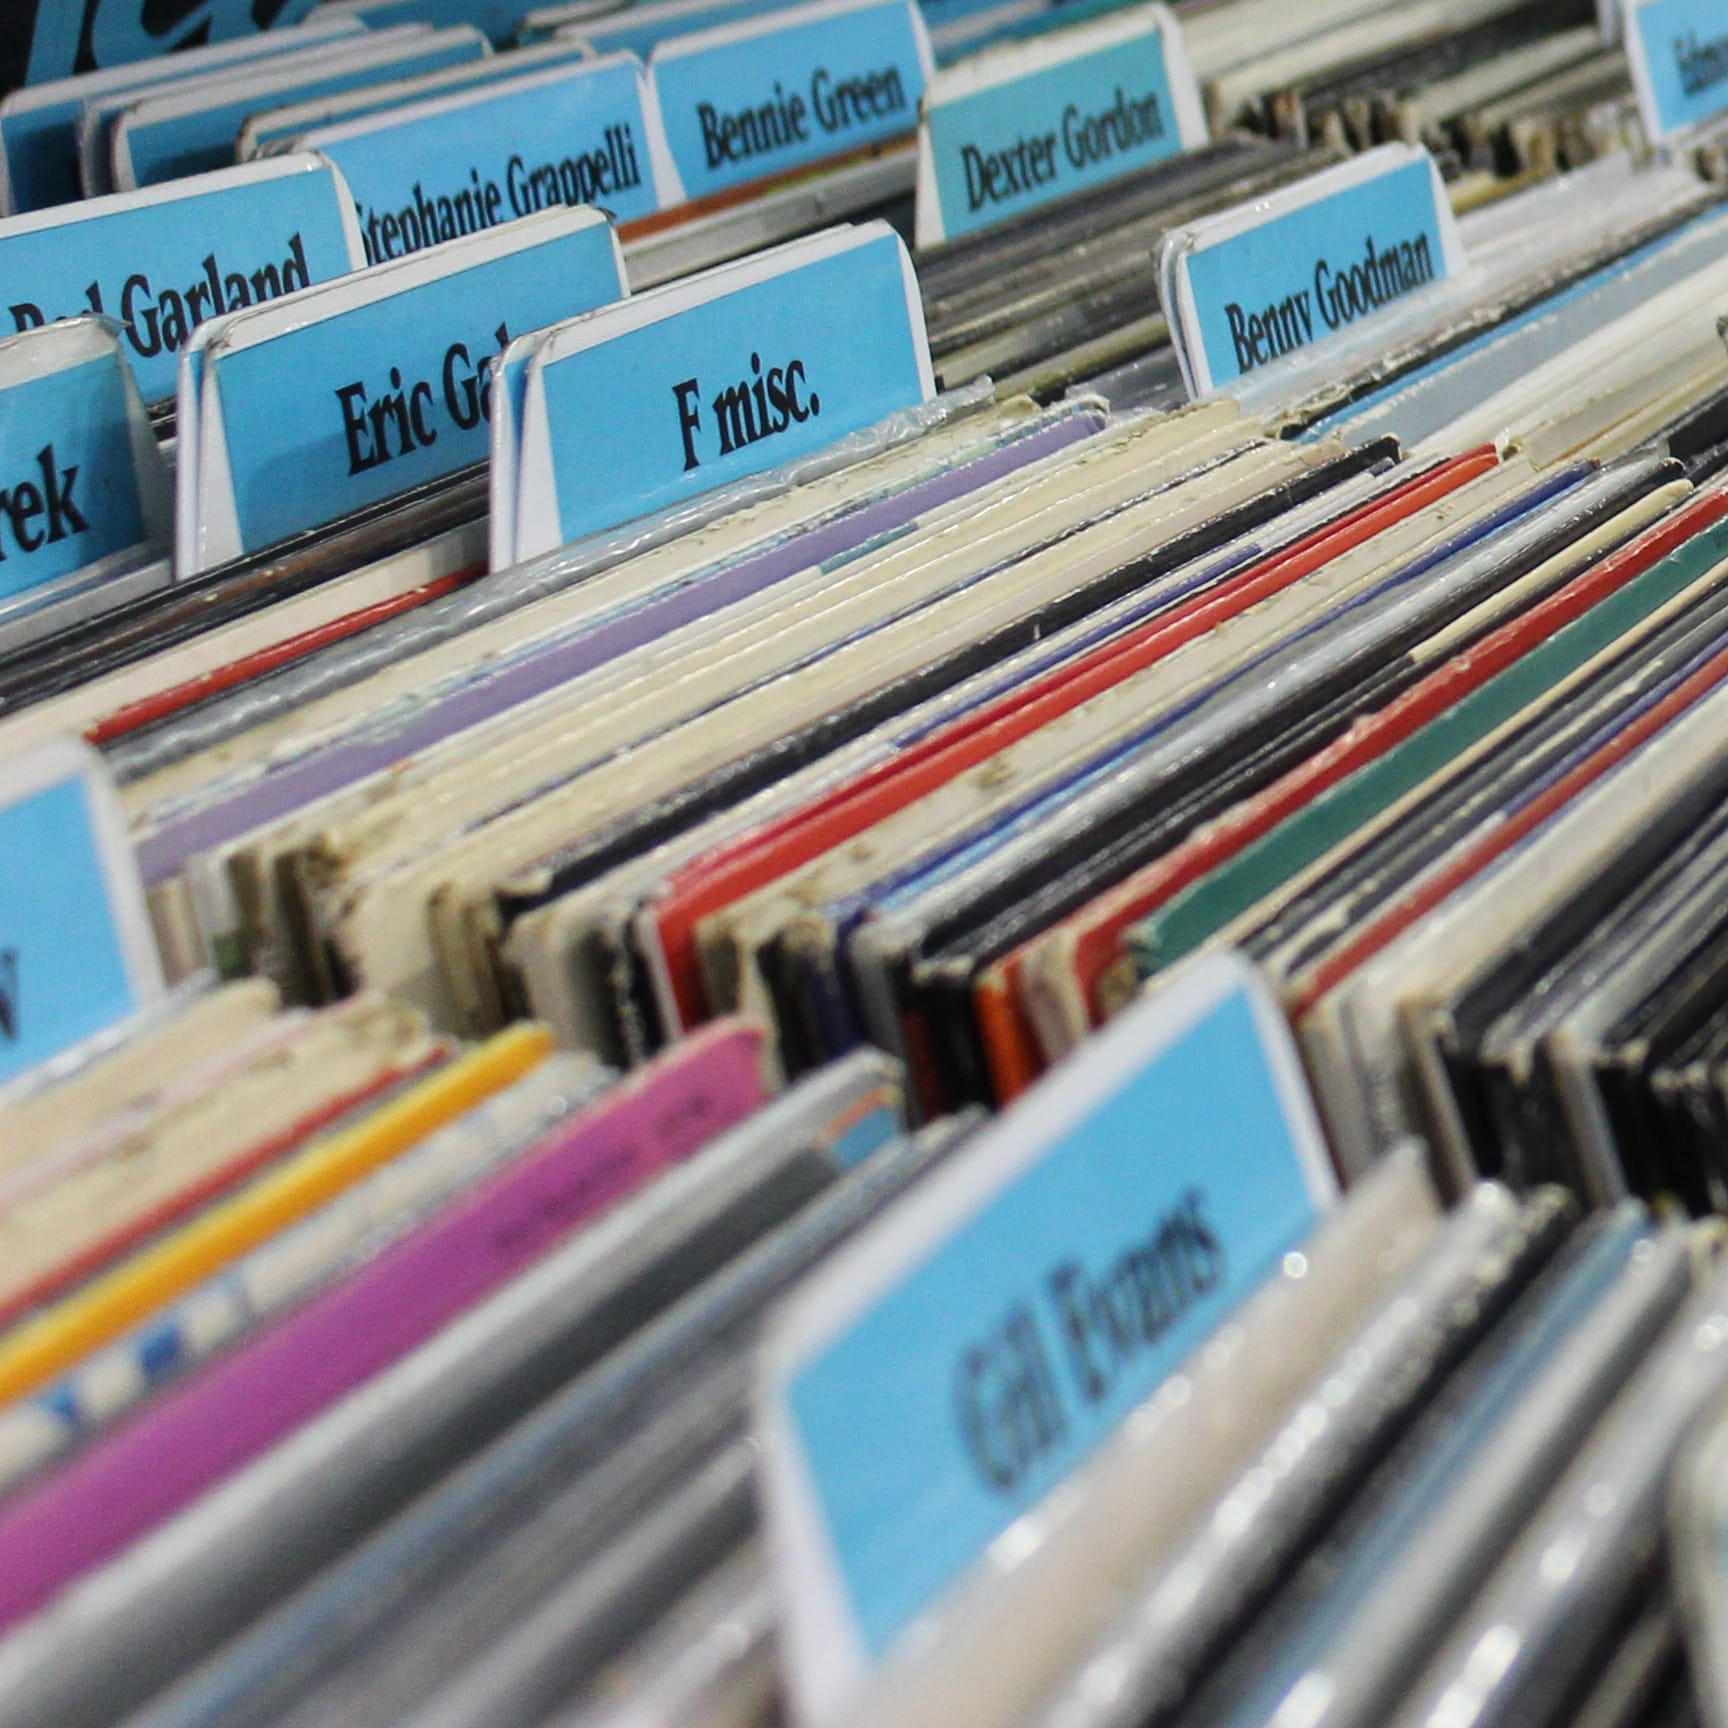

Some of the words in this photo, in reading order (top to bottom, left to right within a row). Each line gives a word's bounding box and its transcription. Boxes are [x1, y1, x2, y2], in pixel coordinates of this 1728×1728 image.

[696, 79, 810, 170] Bennie
[811, 64, 909, 135] Green
[960, 134, 1058, 212] Dexter
[1061, 84, 1165, 170] Gordon
[120, 230, 312, 359] Garland
[1224, 286, 1314, 376] Benny
[1314, 230, 1435, 332] Goodman
[334, 365, 439, 478] Eric
[671, 377, 702, 473] F
[711, 351, 821, 457] misc.
[954, 1296, 1068, 1502] Gil
[1046, 1188, 1231, 1407] Evans
